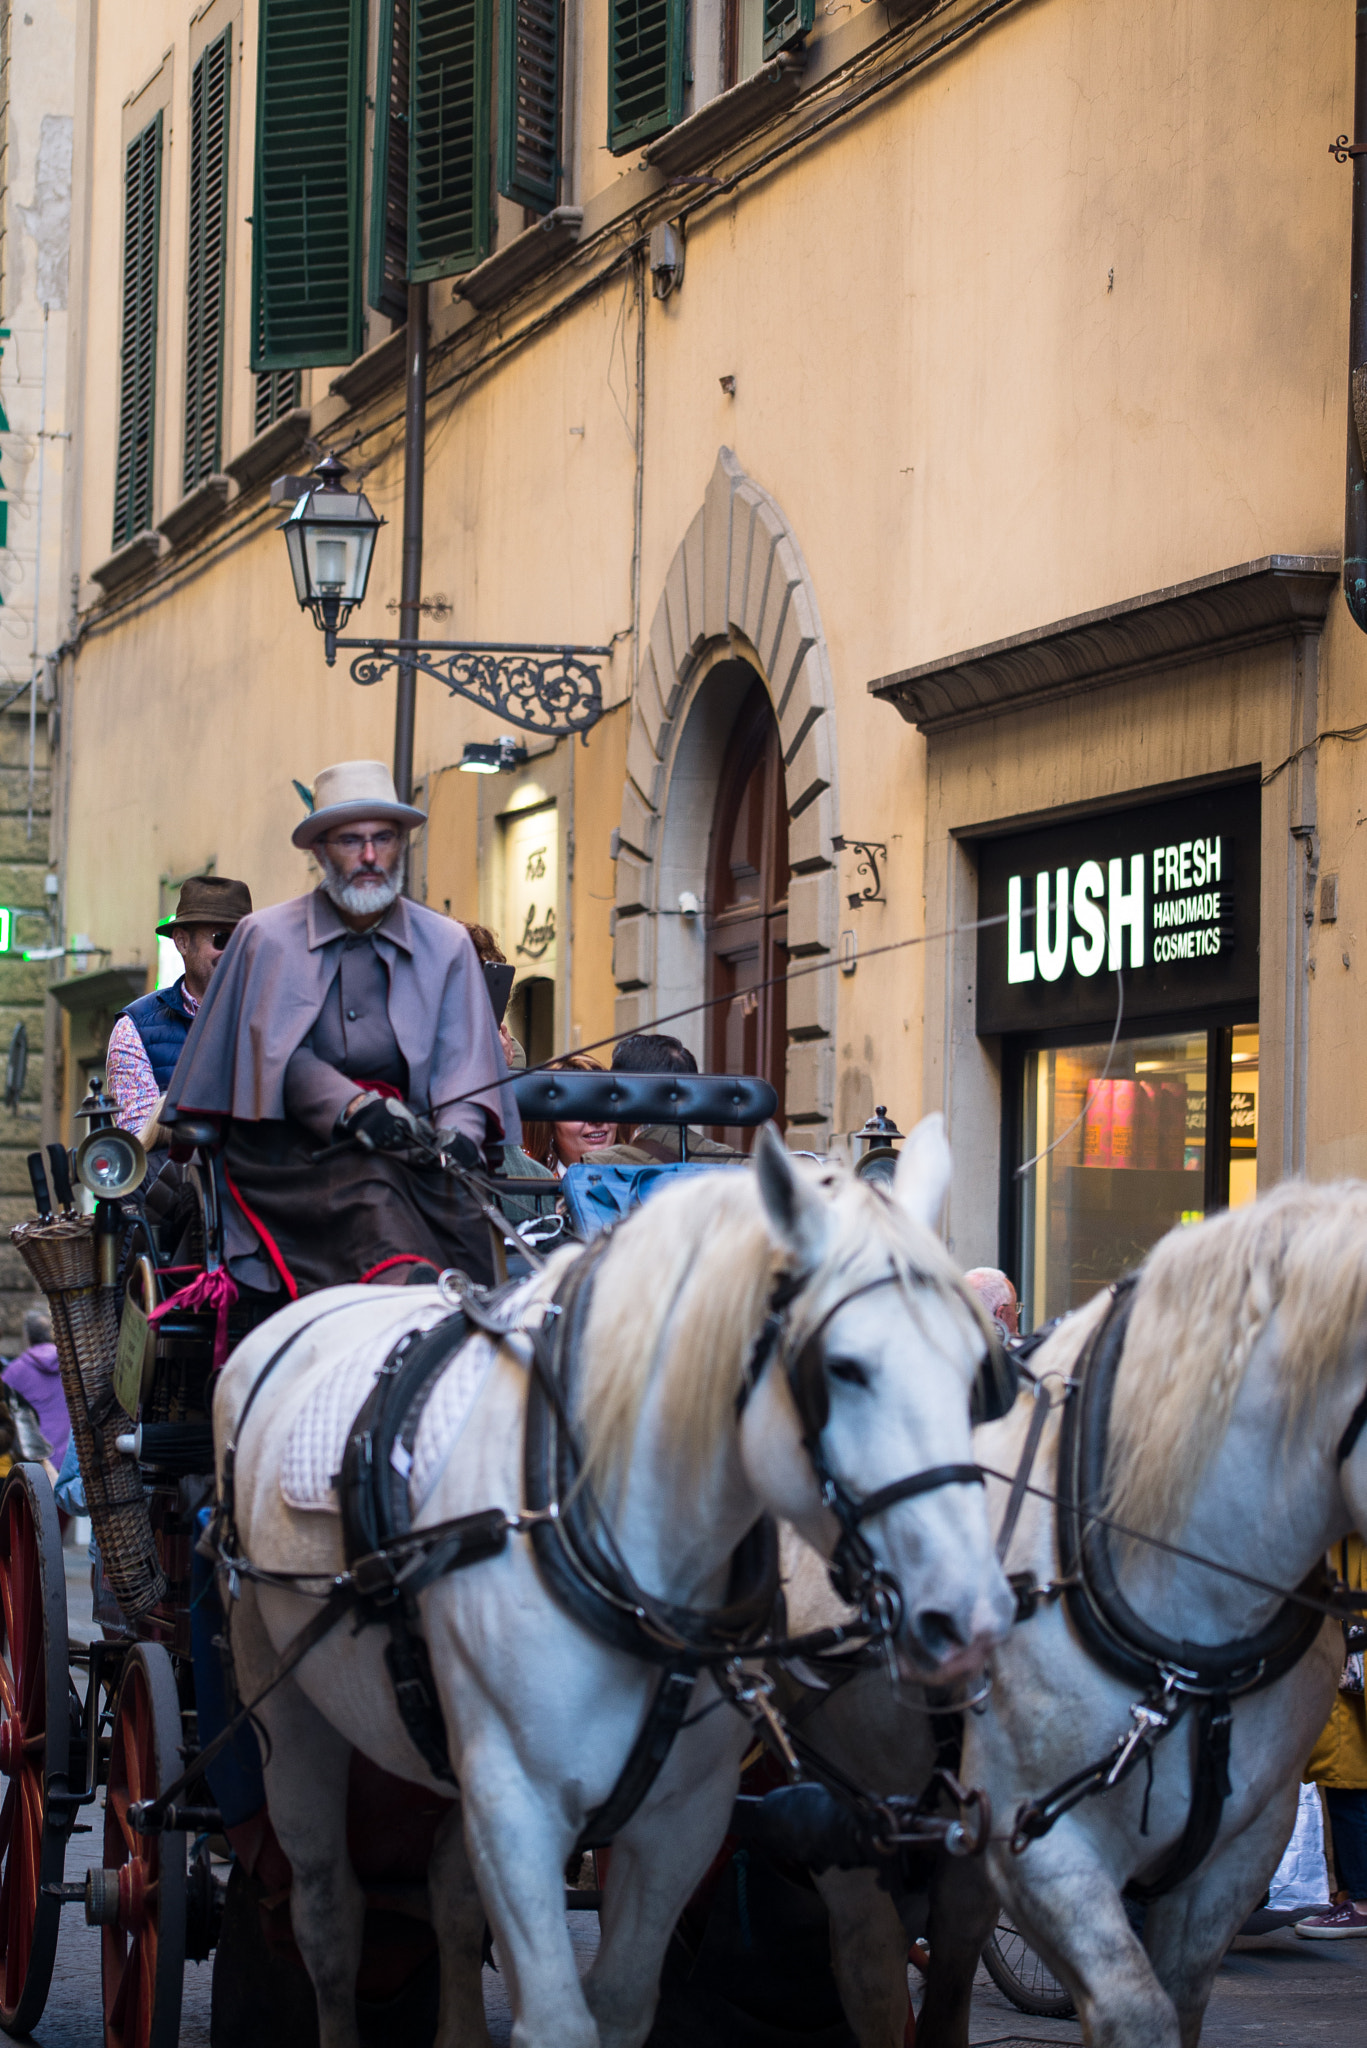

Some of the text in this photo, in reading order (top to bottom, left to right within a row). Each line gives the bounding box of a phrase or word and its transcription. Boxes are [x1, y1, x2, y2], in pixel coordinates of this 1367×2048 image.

[1153, 835, 1221, 895] FRESH
[1008, 853, 1145, 984] LUSH
[1153, 892, 1221, 929] HANDMADE
[1153, 926, 1221, 963] COSMETICS
